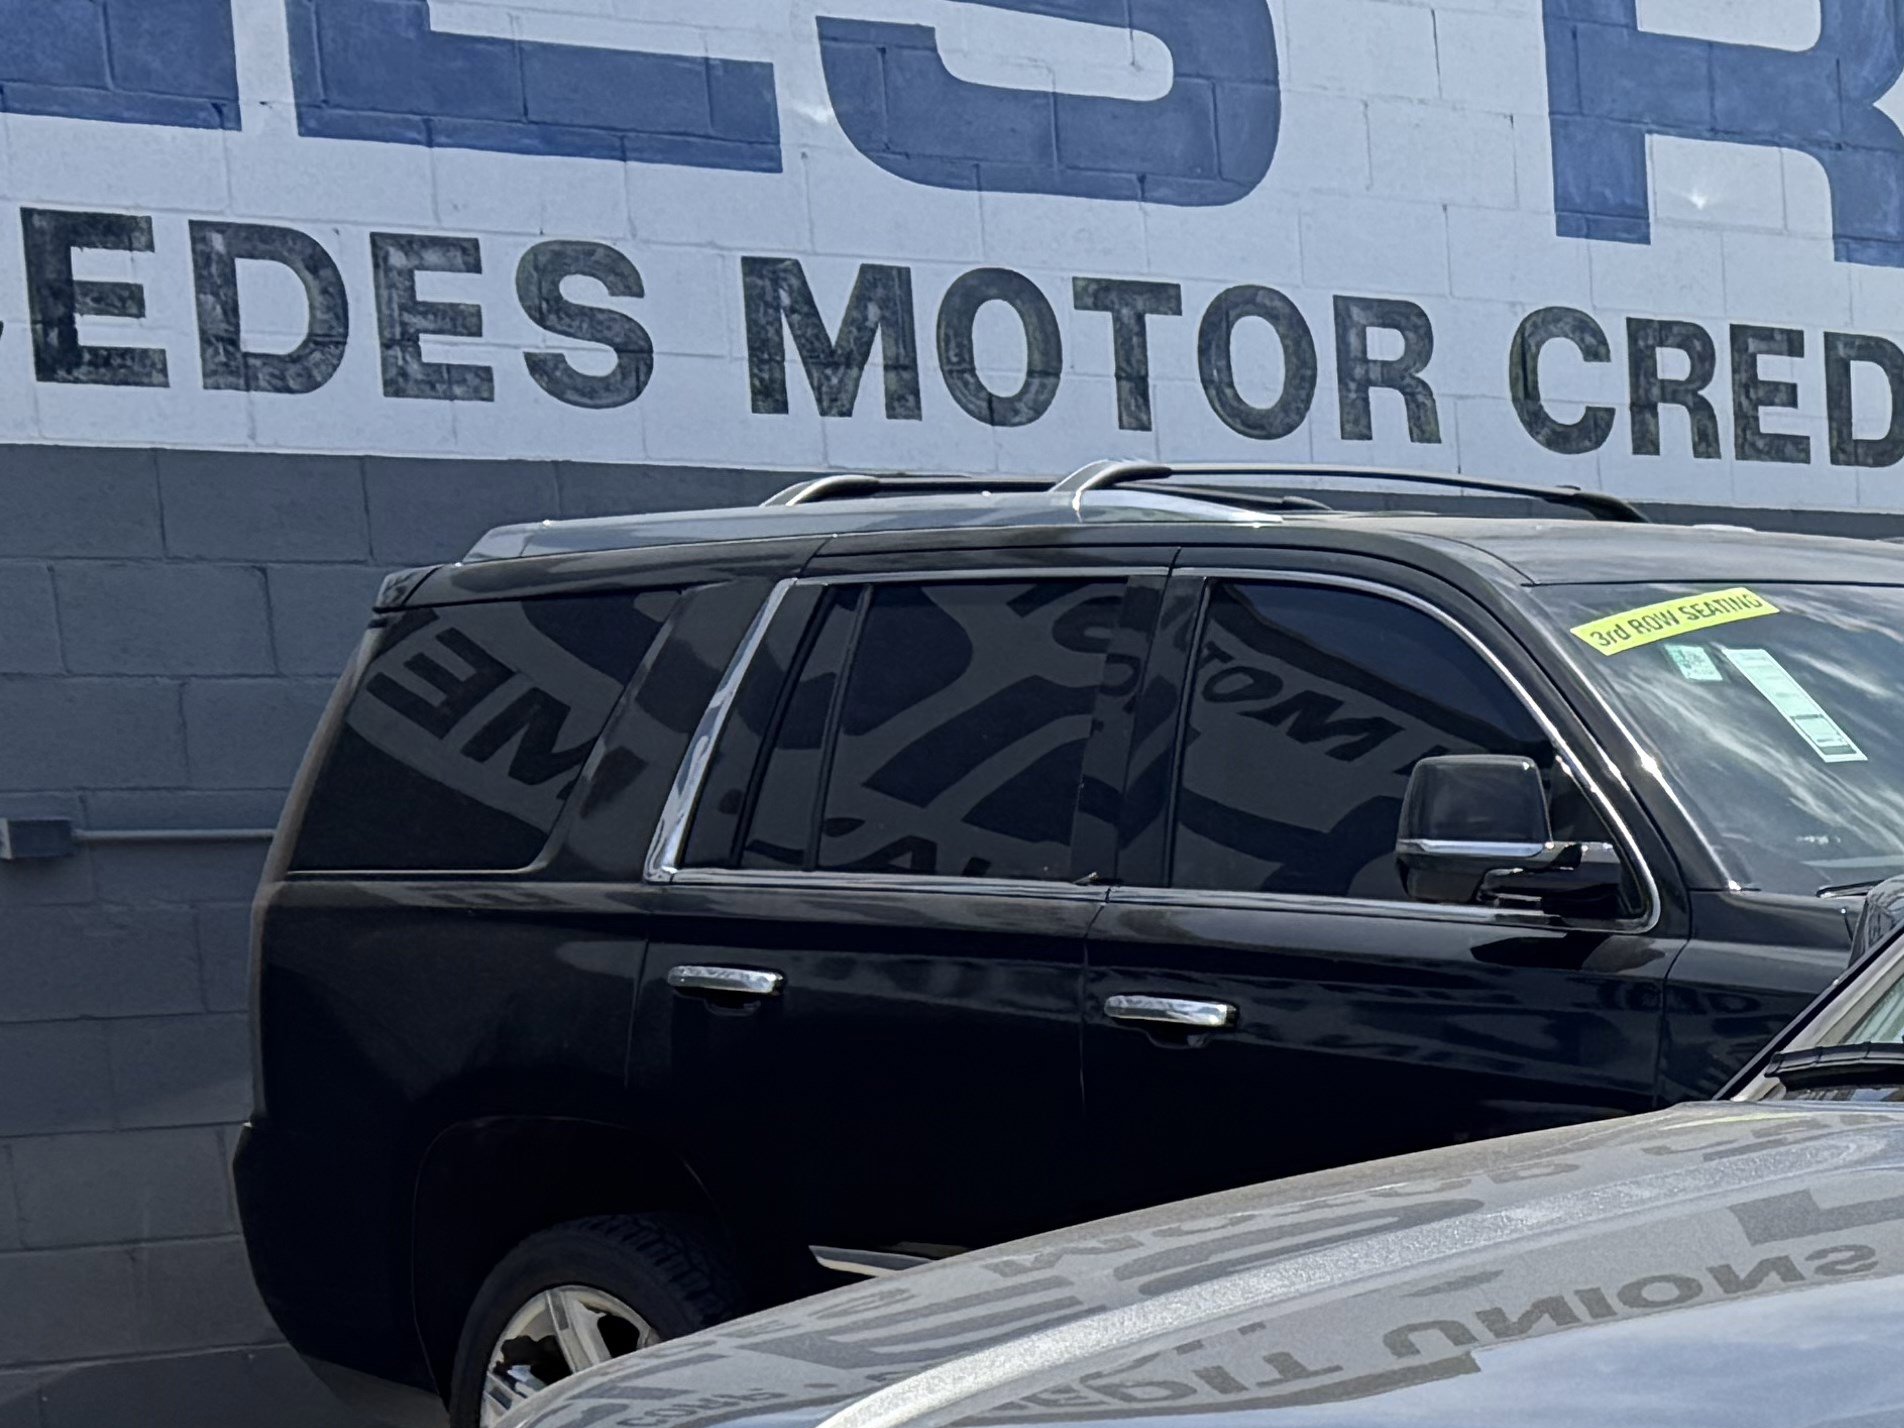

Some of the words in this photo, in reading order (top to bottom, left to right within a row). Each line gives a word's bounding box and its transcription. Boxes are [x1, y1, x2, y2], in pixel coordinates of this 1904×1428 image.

[0, 207, 654, 410] EDES
[740, 256, 1442, 444] MOTOR
[1590, 623, 1631, 647] 3rd
[1633, 609, 1679, 635] ROW
[1678, 593, 1764, 622] SEATING
